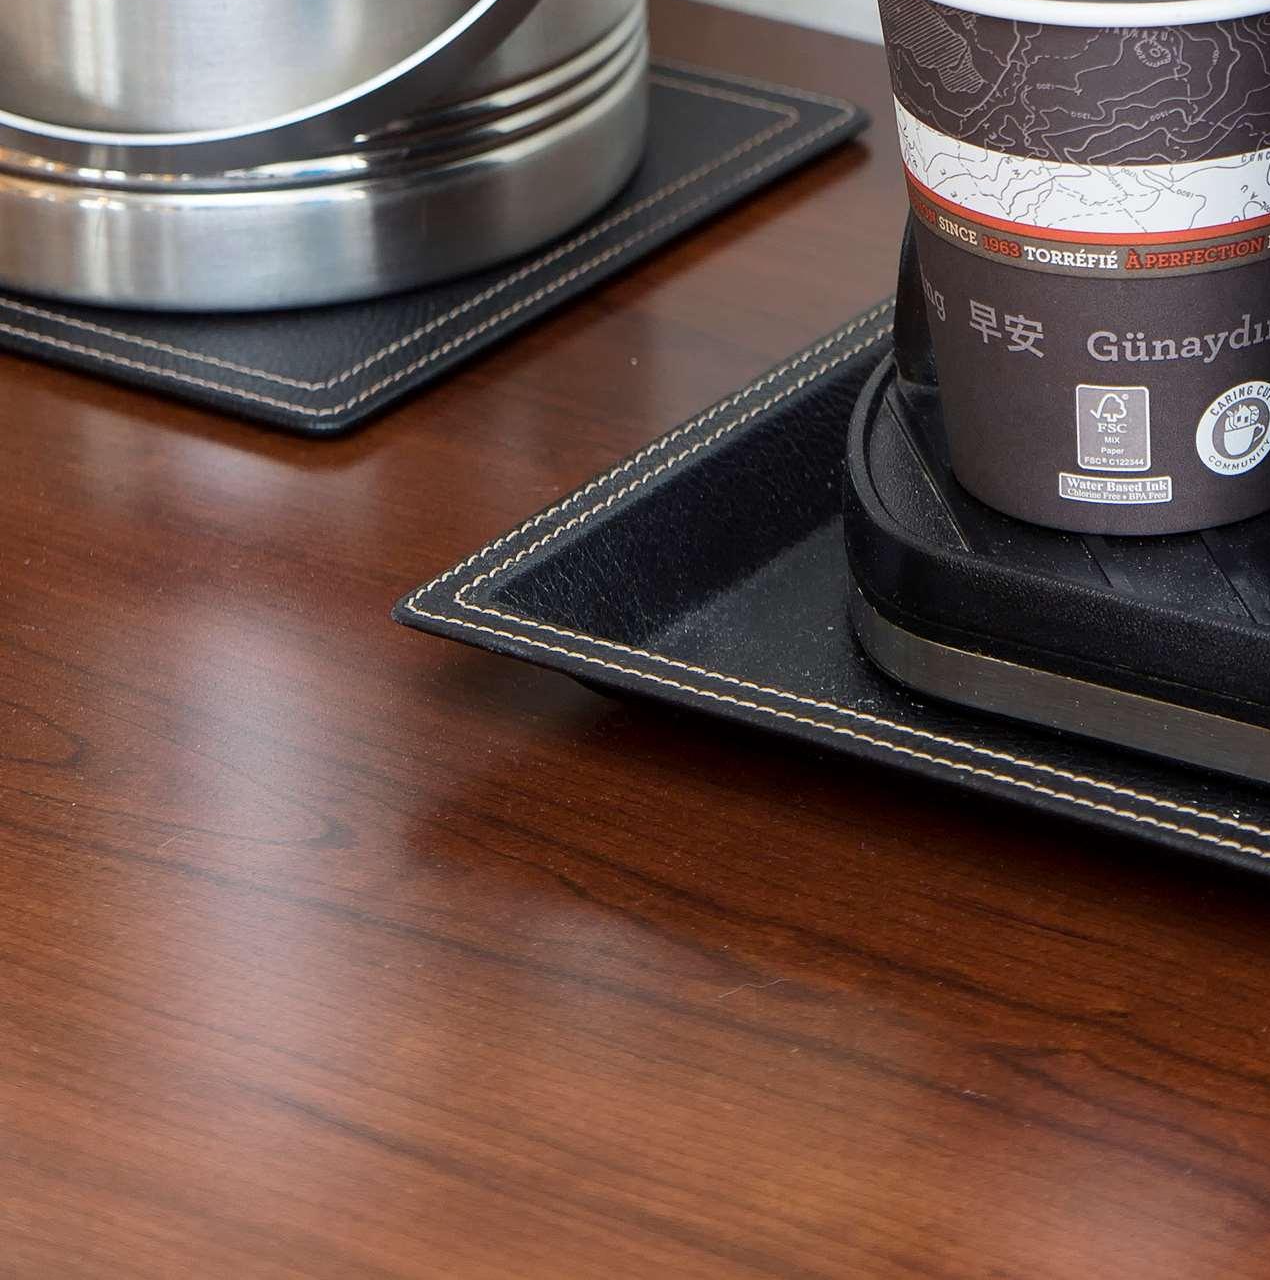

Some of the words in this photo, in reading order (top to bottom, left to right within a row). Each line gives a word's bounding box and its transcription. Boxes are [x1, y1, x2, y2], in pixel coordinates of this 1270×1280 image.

[938, 216, 978, 245] SINCE
[981, 234, 1021, 258] 1963
[1024, 246, 1118, 269] TORRÉFIÉ
[1124, 248, 1143, 270] À
[1143, 237, 1264, 270] PERFECTION
[970, 298, 1044, 359] 早安
[1210, 385, 1253, 416] CARING
[1097, 423, 1128, 433] FSC
[1101, 447, 1124, 456] Paper
[1208, 439, 1270, 471] COMMUNITY
[1067, 477, 1104, 491] Water
[1106, 481, 1142, 492] Based
[1146, 480, 1168, 491] Ink
[1103, 492, 1120, 500] Free
[1129, 492, 1147, 500] BPA
[1149, 491, 1166, 499] Free
